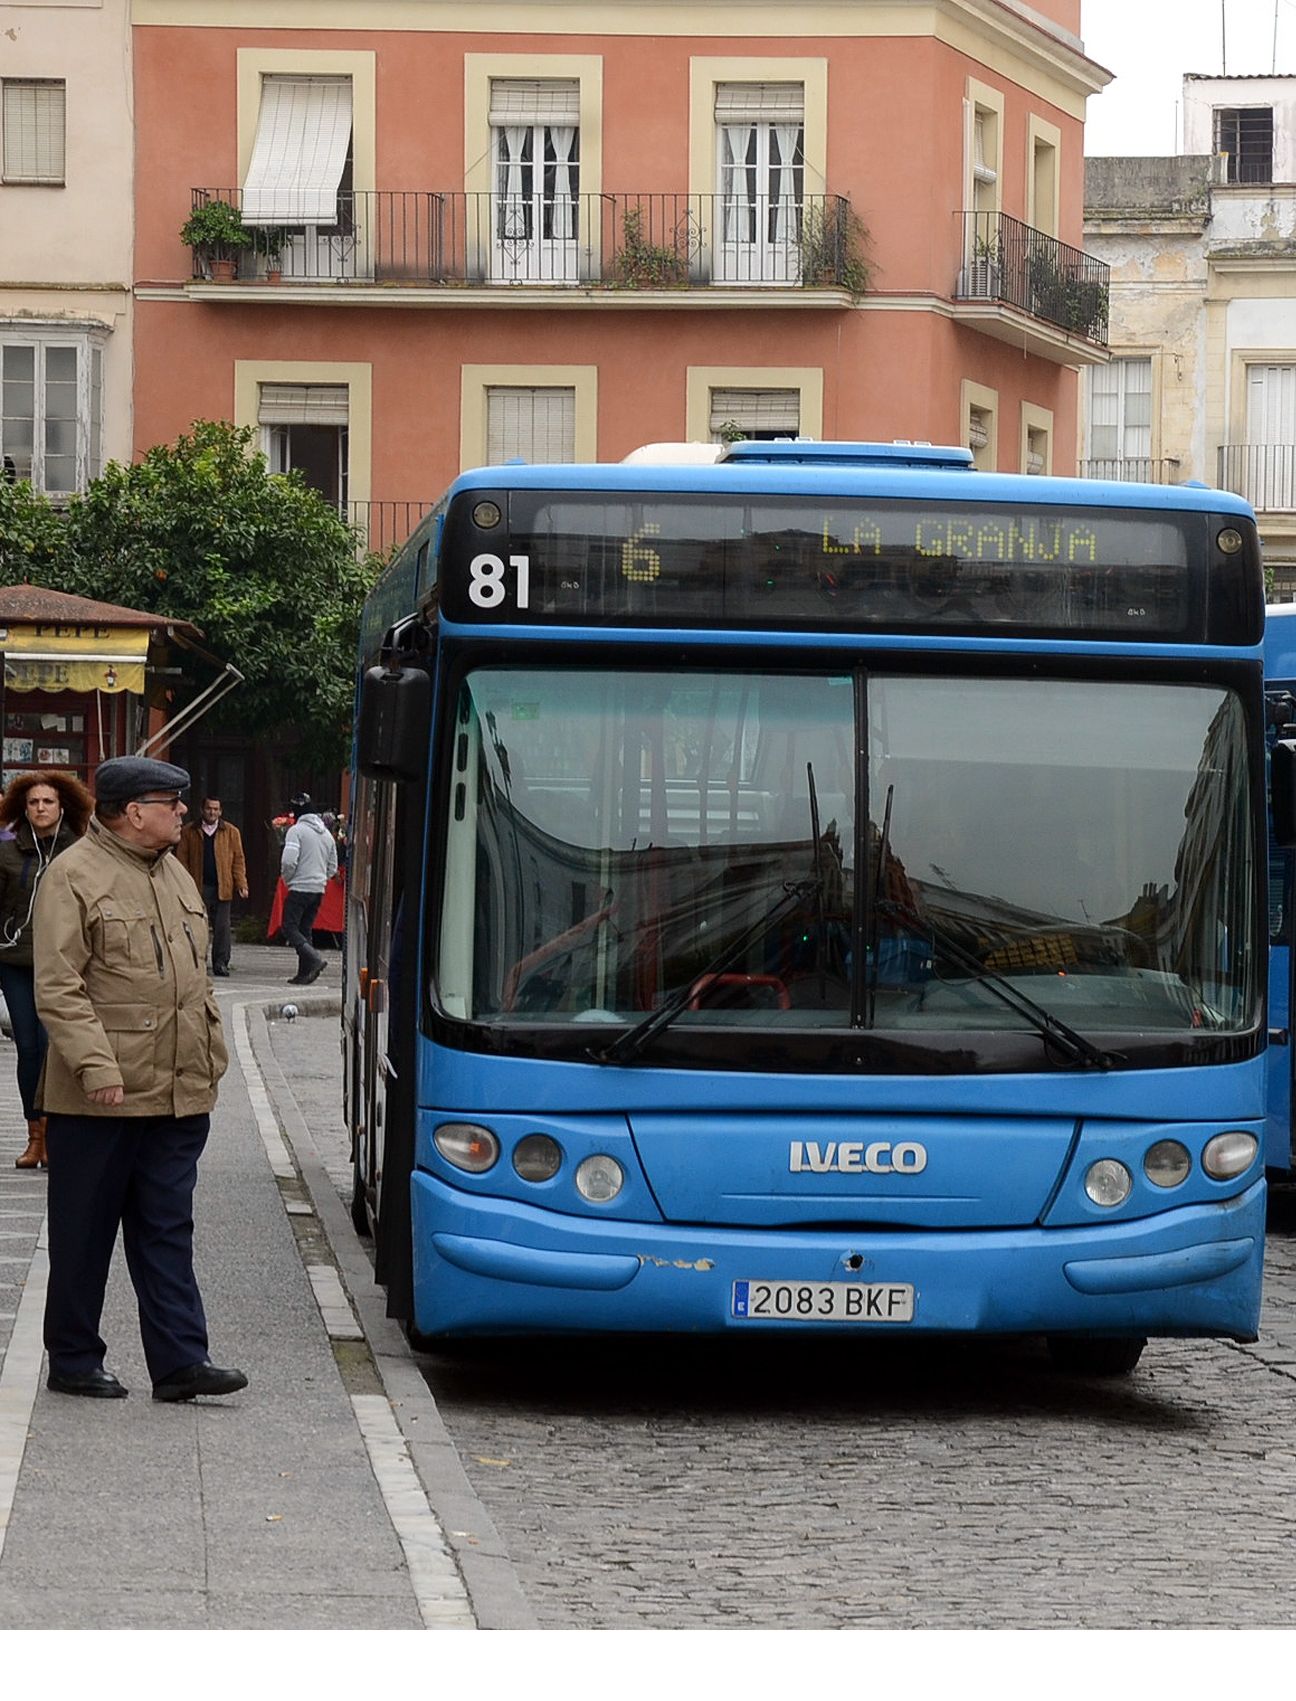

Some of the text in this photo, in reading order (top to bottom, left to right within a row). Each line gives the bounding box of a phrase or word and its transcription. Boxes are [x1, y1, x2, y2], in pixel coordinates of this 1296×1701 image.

[621, 522, 660, 582] 6
[822, 515, 1096, 561] LA GRANJA
[468, 553, 530, 609] 81
[789, 1141, 927, 1173] IVECO
[753, 1286, 835, 1315] 2083
[845, 1287, 906, 1317] BKF
